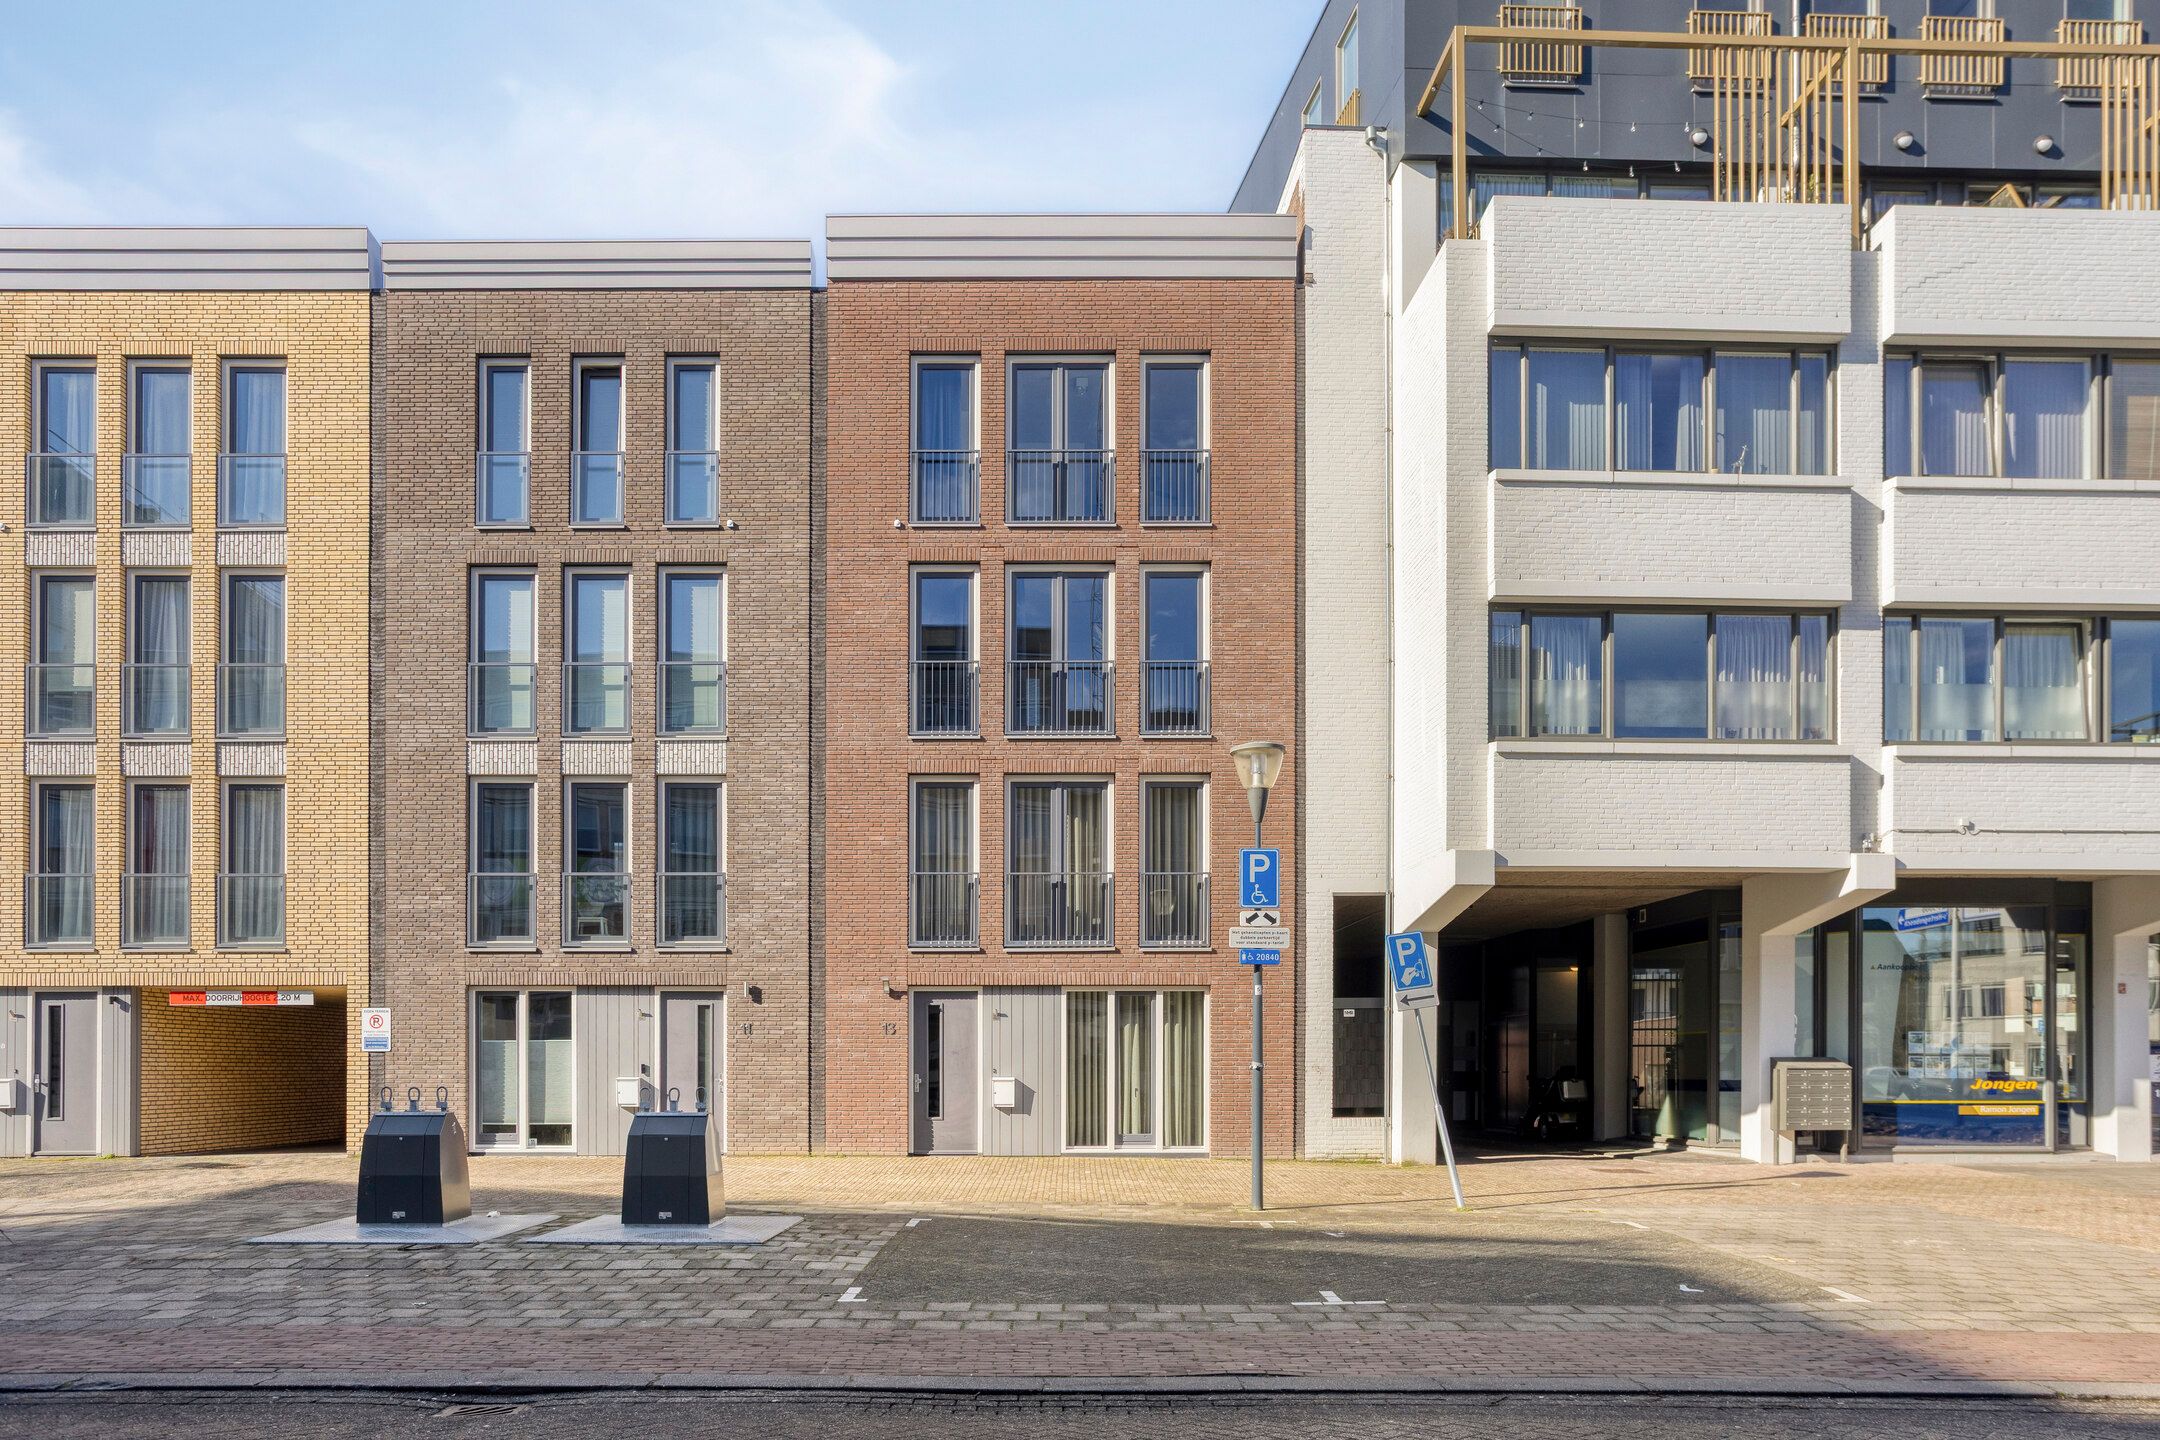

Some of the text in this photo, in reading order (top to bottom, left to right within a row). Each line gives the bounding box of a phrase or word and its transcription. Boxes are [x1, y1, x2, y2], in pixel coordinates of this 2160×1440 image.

[1250, 853, 1270, 882] P
[1256, 953, 1280, 961] 20840
[1396, 938, 1416, 966] P
[882, 1022, 897, 1036] 13
[1970, 1078, 2038, 1093] Jongen
[1980, 1105, 2036, 1115] Ramon Jongen
